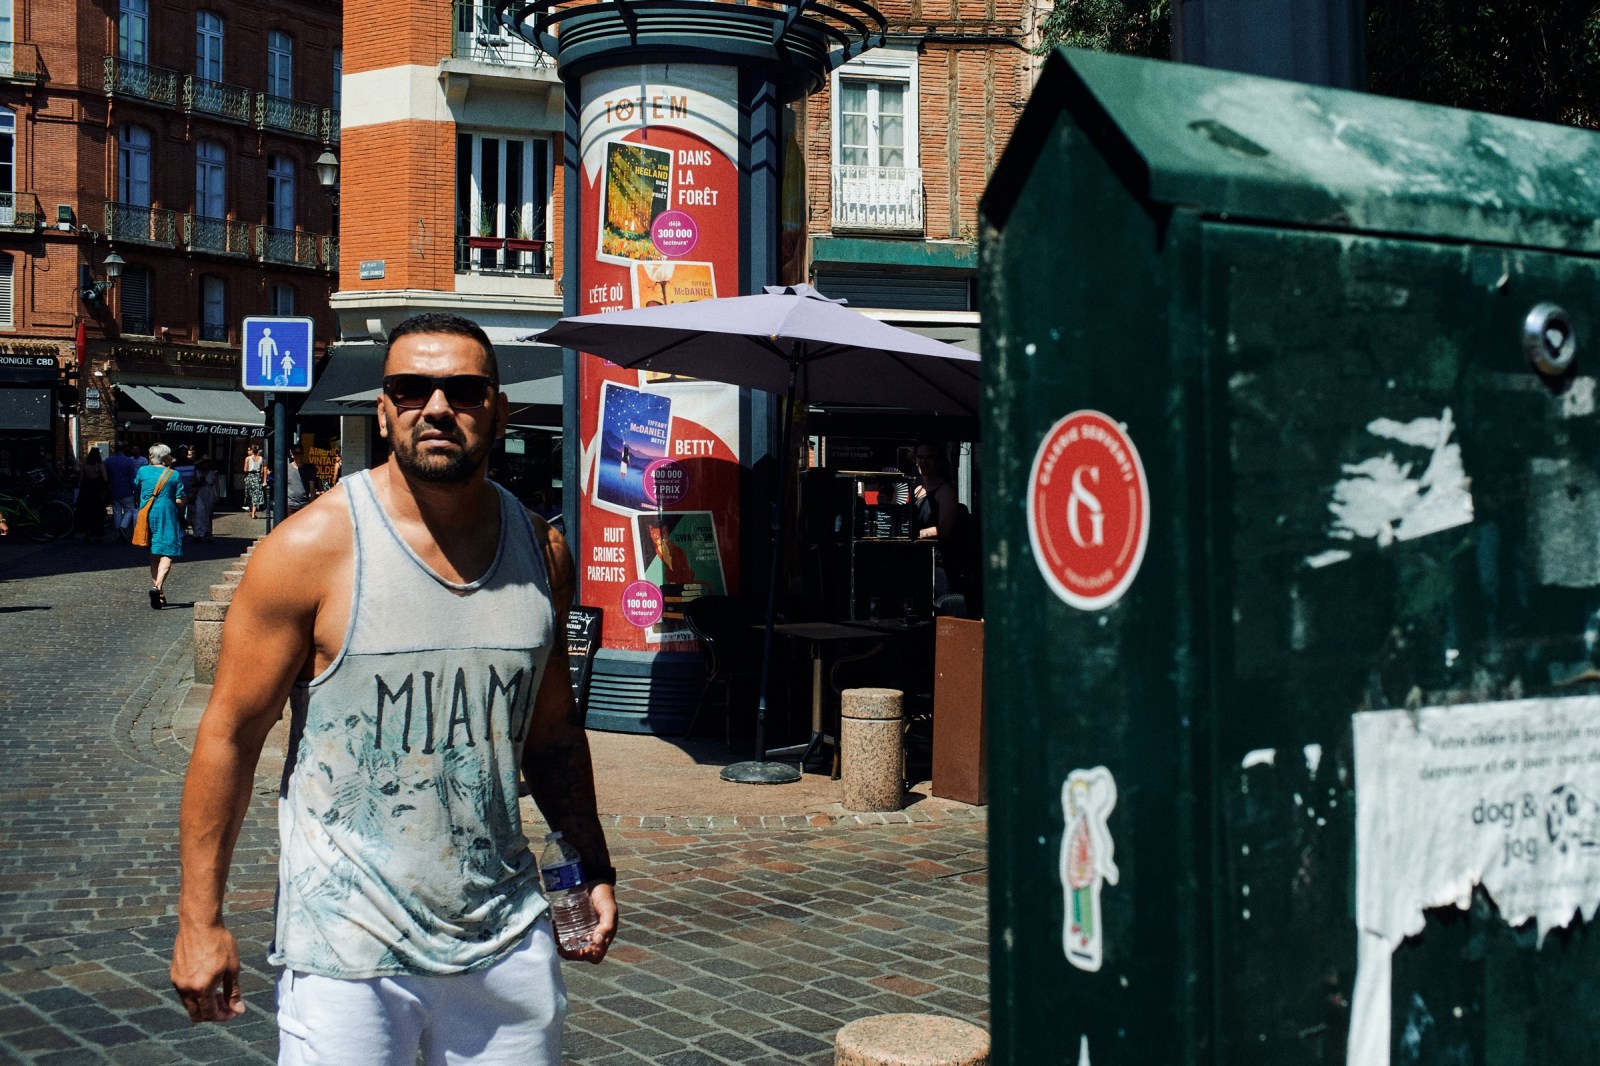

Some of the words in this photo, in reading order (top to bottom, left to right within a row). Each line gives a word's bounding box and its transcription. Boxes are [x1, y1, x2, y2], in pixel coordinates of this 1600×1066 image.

[604, 96, 687, 123] TOTEM
[679, 150, 712, 166] DANS
[635, 166, 668, 180] HEGLAND
[679, 170, 694, 185] LA
[679, 187, 718, 206] FORÊT
[658, 229, 674, 238] 300
[676, 229, 692, 238] 000
[590, 284, 608, 304] L'ÉTÉ
[610, 283, 623, 302] OÙ
[674, 287, 713, 296] McDANIEL
[36, 358, 54, 366] CBD
[166, 422, 194, 432] Maison
[196, 424, 208, 433] De
[210, 425, 239, 435] Oliveira
[241, 427, 249, 435] &
[250, 427, 265, 438] Fils
[630, 423, 666, 439] McDANIEL
[651, 437, 666, 445] BETTY
[675, 440, 714, 455] BETTY
[651, 470, 665, 478] 400
[667, 470, 682, 478] 000
[604, 527, 625, 542] HUIT
[593, 546, 625, 562] CRIMES
[587, 566, 625, 582] PARFAITS
[627, 599, 640, 608] 100
[642, 600, 657, 609] 000
[374, 664, 537, 754] MIAMI
[1472, 798, 1514, 828] dog
[1522, 792, 1537, 818] &
[1502, 833, 1540, 868] jog
